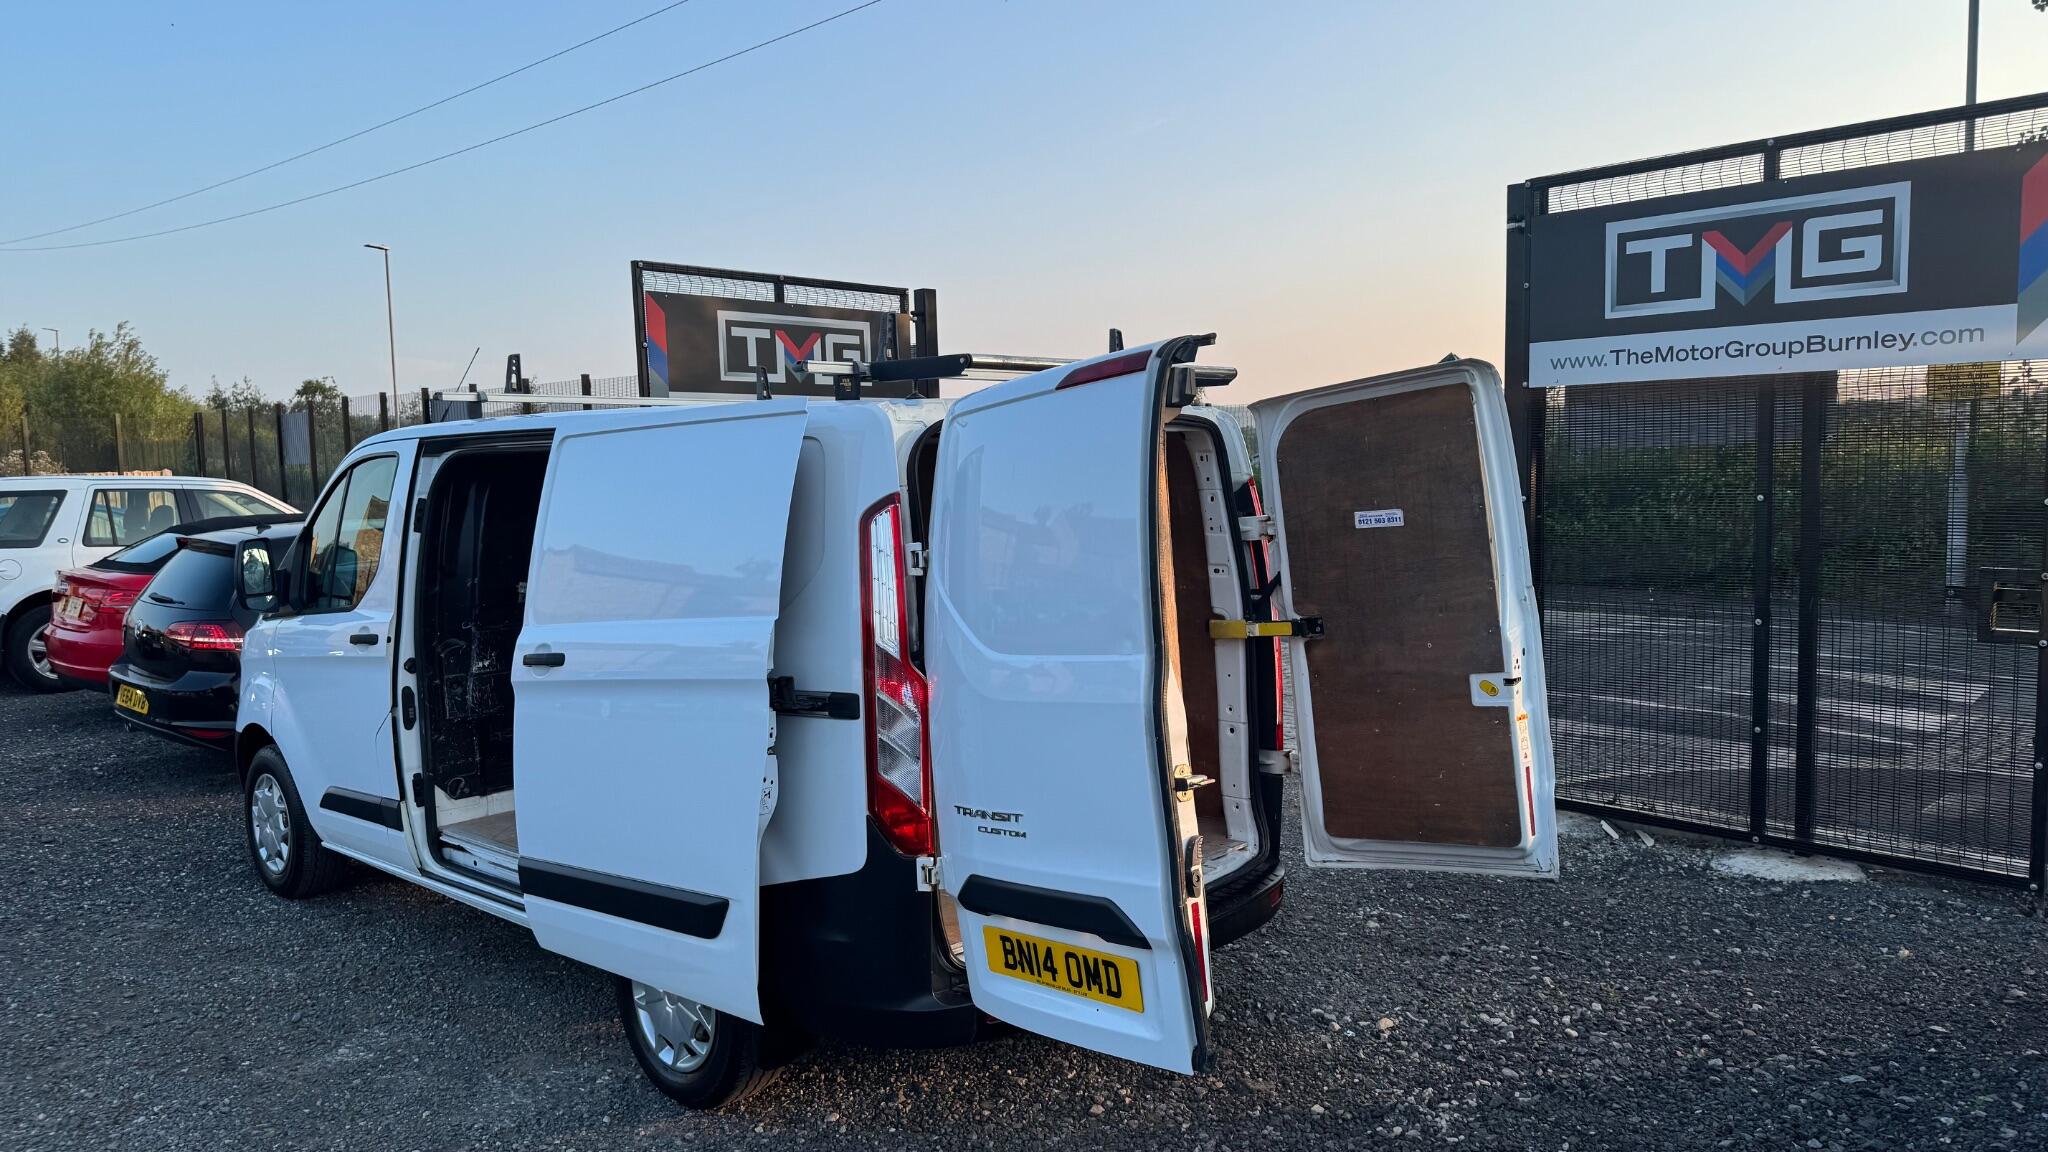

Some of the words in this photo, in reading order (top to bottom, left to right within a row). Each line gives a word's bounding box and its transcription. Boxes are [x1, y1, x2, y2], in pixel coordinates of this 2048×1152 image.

[1626, 209, 1884, 307] TMG
[730, 325, 860, 383] TMG
[1550, 327, 1985, 370] www.TheMotorGroupBurnley.com
[954, 805, 1024, 823] TRANSIT
[978, 825, 1027, 839] CUSTOM
[1000, 934, 1058, 982] BN14
[1064, 951, 1122, 999] OMD
